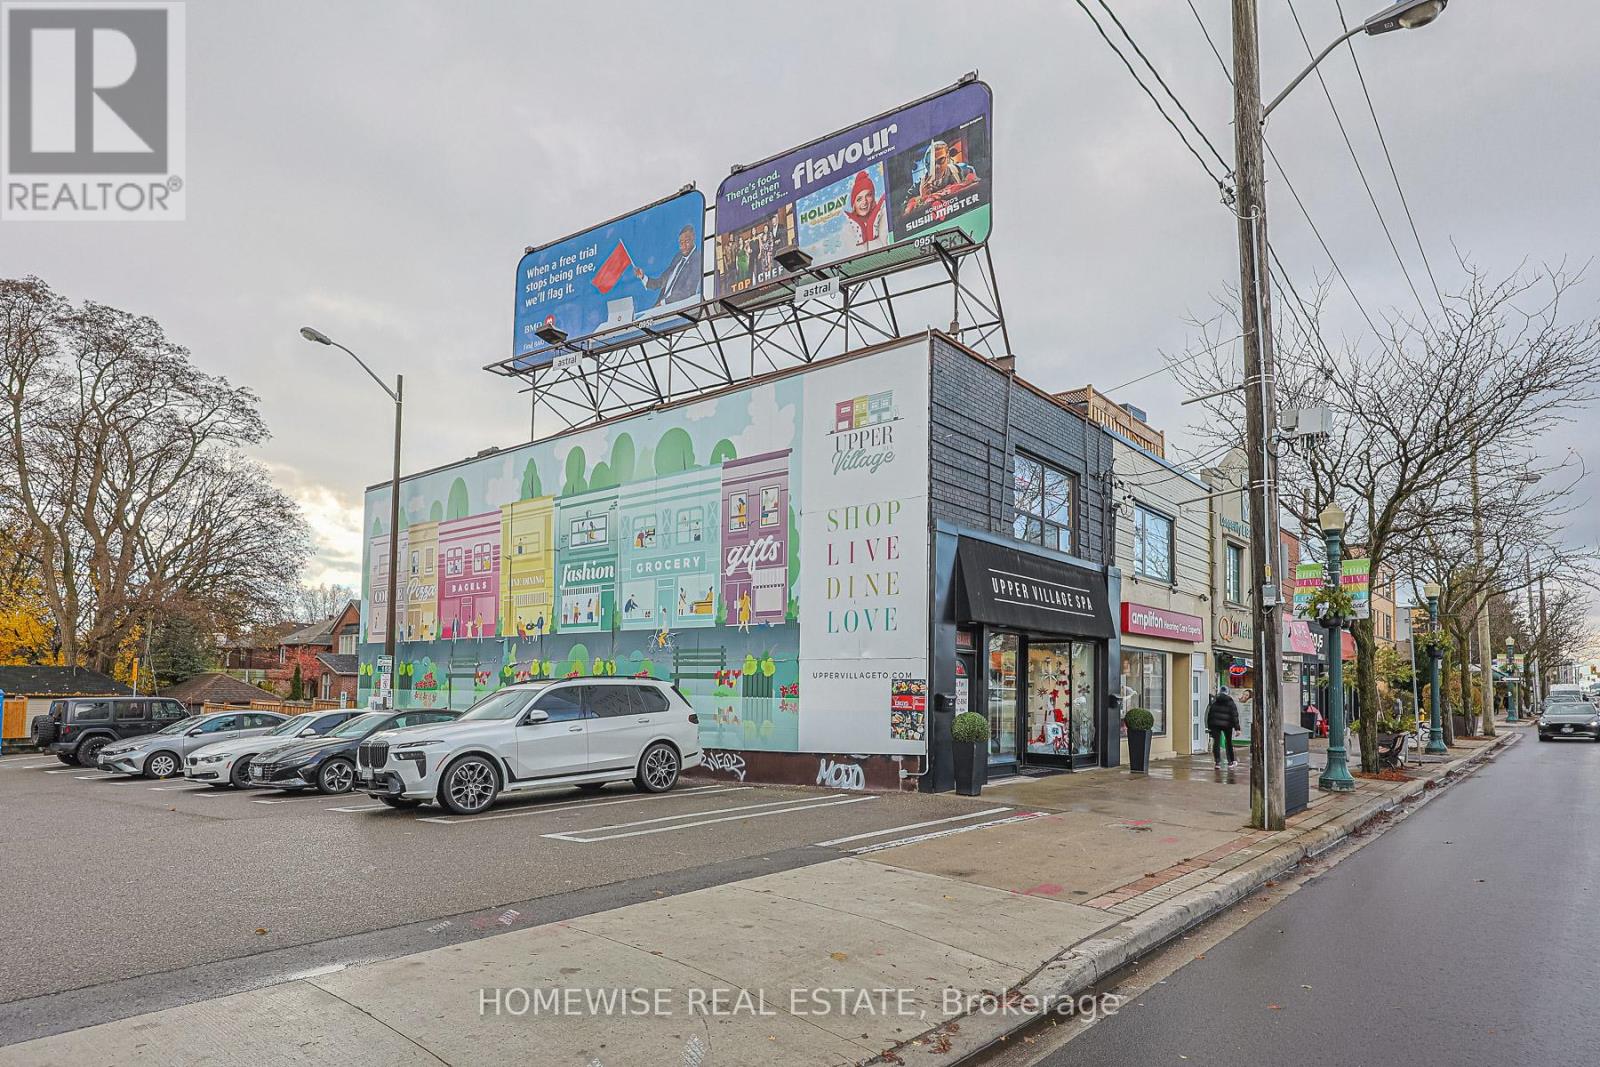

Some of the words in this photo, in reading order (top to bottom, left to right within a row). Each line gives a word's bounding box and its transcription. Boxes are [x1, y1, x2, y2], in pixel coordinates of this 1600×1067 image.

[791, 123, 898, 190] flavour
[725, 182, 757, 202] There's
[757, 171, 781, 190] food.
[741, 193, 758, 206] And
[760, 182, 780, 199] then
[800, 194, 848, 225] HOLIDAY
[914, 234, 937, 248] 0951
[526, 265, 549, 279] When
[559, 257, 577, 270] free
[579, 244, 598, 260] trial
[525, 277, 547, 293] stops
[550, 268, 573, 284] being
[575, 261, 596, 277] free,
[731, 278, 752, 293] TOP
[758, 265, 784, 283] CHEF
[803, 282, 831, 297] astral
[525, 292, 545, 308] we'll
[547, 286, 564, 302] flag
[565, 283, 575, 296] it.
[557, 355, 577, 366] astral
[835, 425, 893, 453] UPPER
[831, 447, 895, 475] Village
[827, 499, 901, 533] SHOP
[725, 535, 781, 576] gifts
[827, 535, 900, 566] LIVE
[560, 561, 615, 589] fashion
[635, 556, 701, 574] GROCERY
[451, 581, 488, 593] BAGELS
[827, 571, 899, 600] DINE
[991, 577, 1029, 599] UPPER
[1032, 585, 1073, 607] VILLAGE
[1076, 594, 1093, 611] SPA
[827, 607, 898, 634] LOVE
[1131, 610, 1164, 630] amplifon
[812, 671, 912, 680] UPPERVILLAGETO.COM
